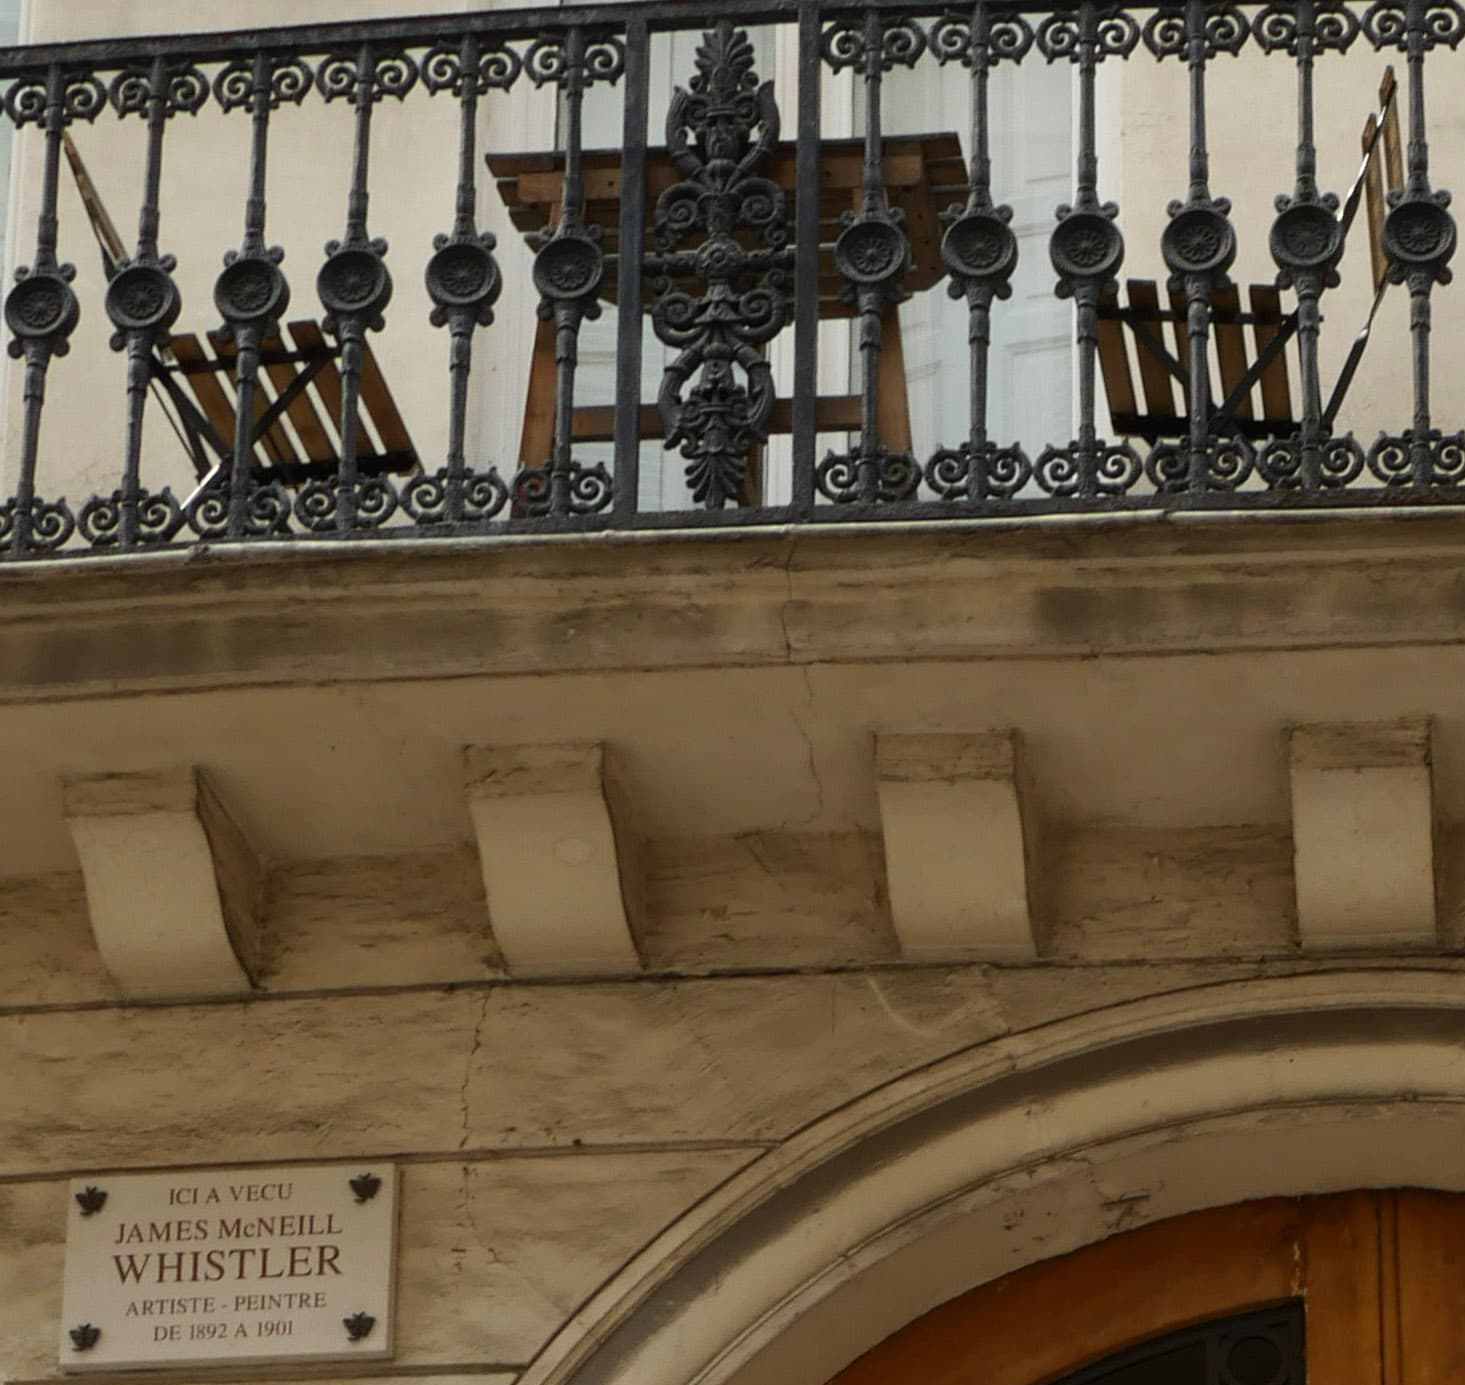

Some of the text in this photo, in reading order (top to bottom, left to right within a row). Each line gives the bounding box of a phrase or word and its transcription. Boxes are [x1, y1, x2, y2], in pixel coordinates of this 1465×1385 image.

[169, 1183, 293, 1205] ICI A VECU
[115, 1214, 343, 1244] JAMES McNEILL
[113, 1245, 343, 1285] WHISTLER
[126, 1297, 215, 1317] ARTISTE
[234, 1293, 327, 1312] PEINTRE
[154, 1321, 293, 1341] DE 1892 A 1901
